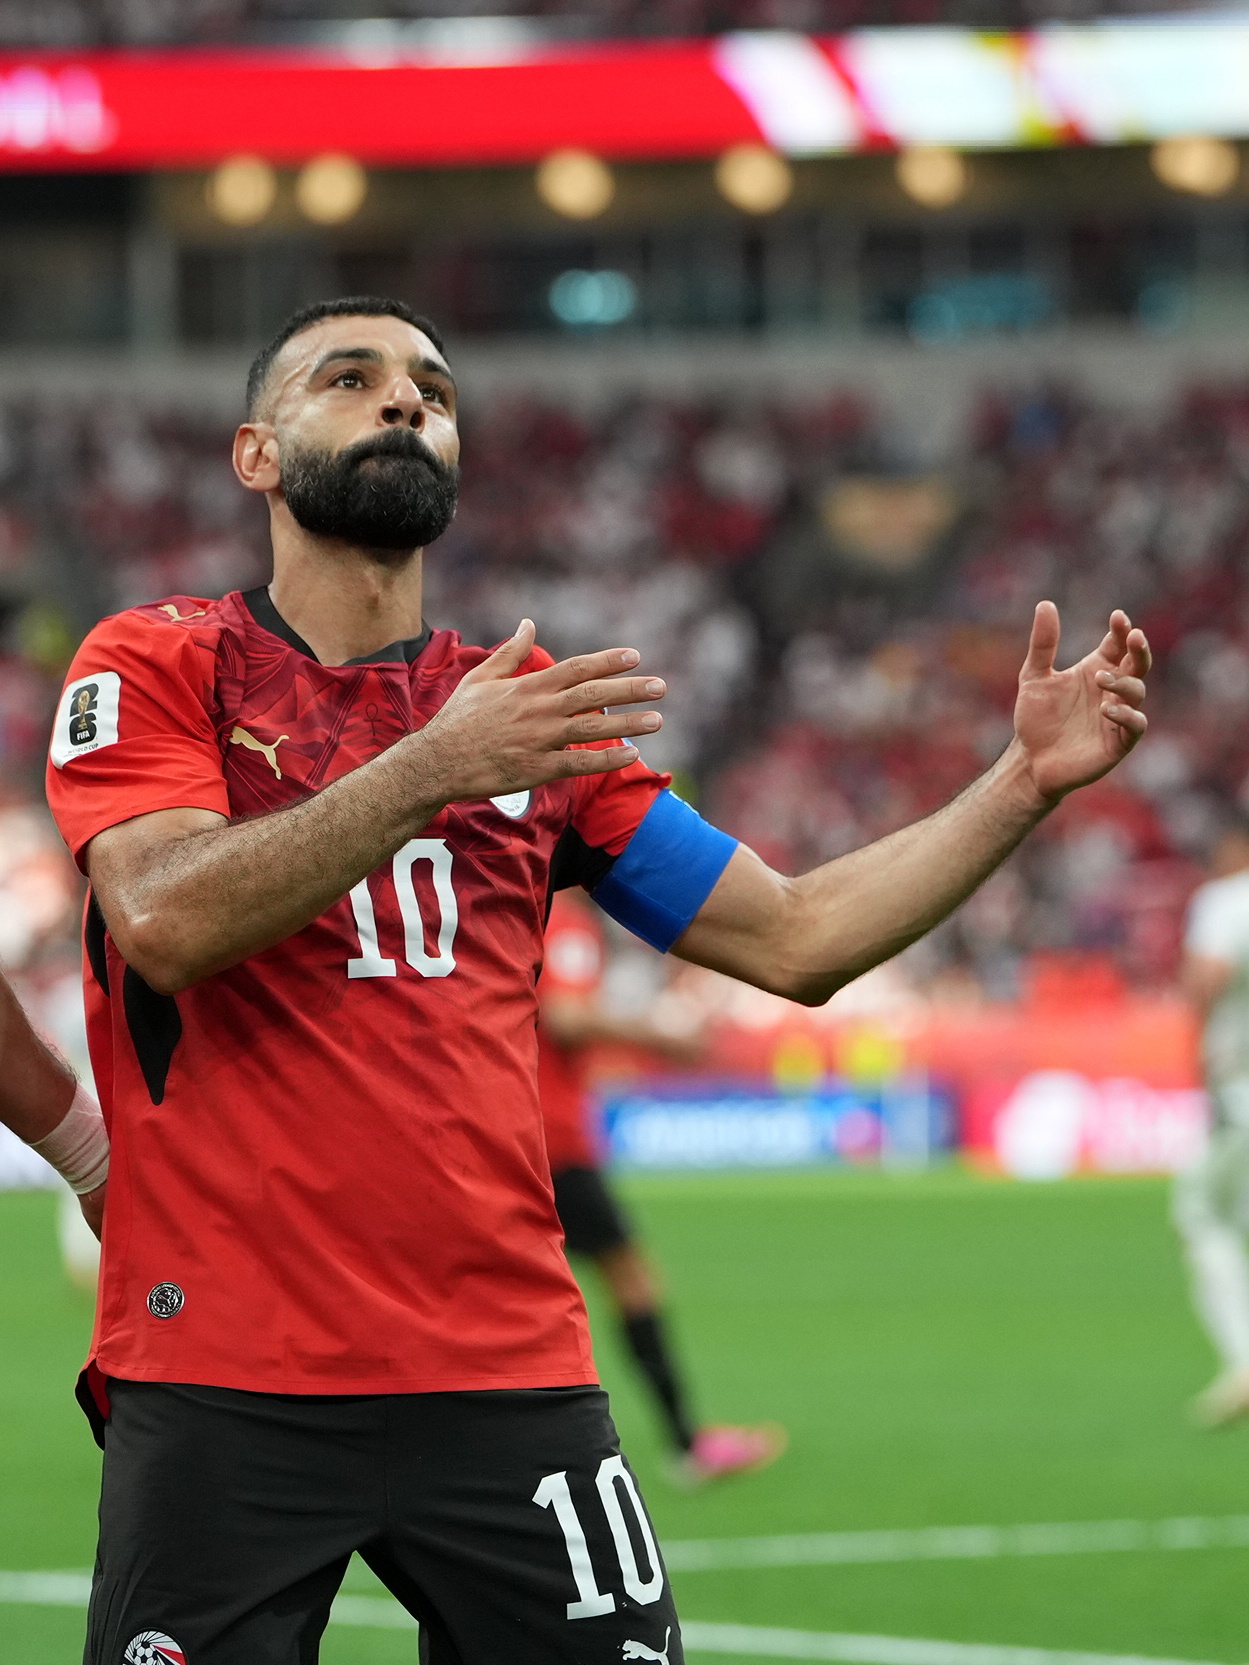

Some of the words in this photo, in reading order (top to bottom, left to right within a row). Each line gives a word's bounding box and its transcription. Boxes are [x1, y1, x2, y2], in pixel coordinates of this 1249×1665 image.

[77, 730, 90, 741] FIFA
[348, 839, 458, 979] 10
[532, 1455, 664, 1620] 10
